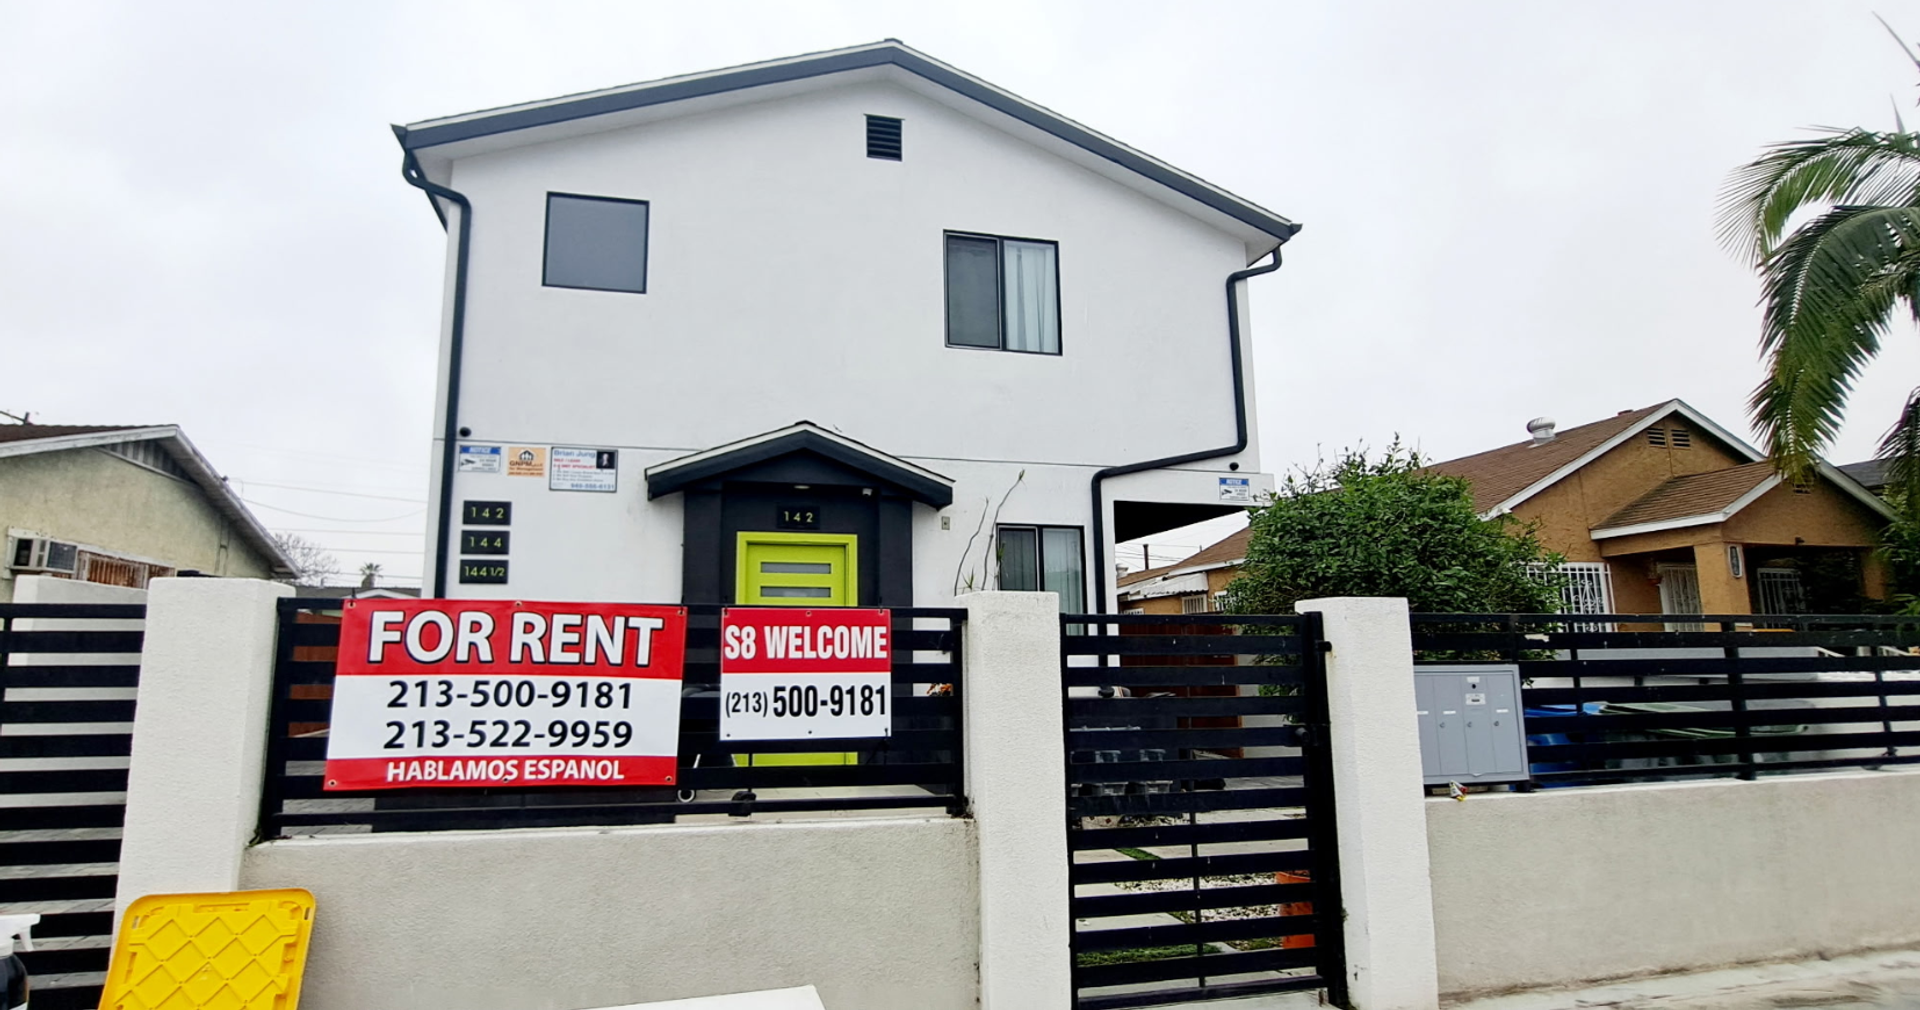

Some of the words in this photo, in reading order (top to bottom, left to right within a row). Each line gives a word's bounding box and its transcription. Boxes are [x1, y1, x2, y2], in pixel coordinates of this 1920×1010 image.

[576, 451, 596, 459] Jung
[367, 610, 495, 665] FOR
[509, 611, 665, 668] RENT
[724, 625, 756, 660] S8
[763, 625, 888, 660] WELCOME
[387, 680, 632, 709] 213-500-9181
[725, 692, 768, 718] (213)
[773, 685, 886, 718] 500-9181
[383, 720, 633, 749] 213-522-9959
[386, 759, 519, 783] HABLAMOS
[523, 759, 625, 781] ESPANOL
